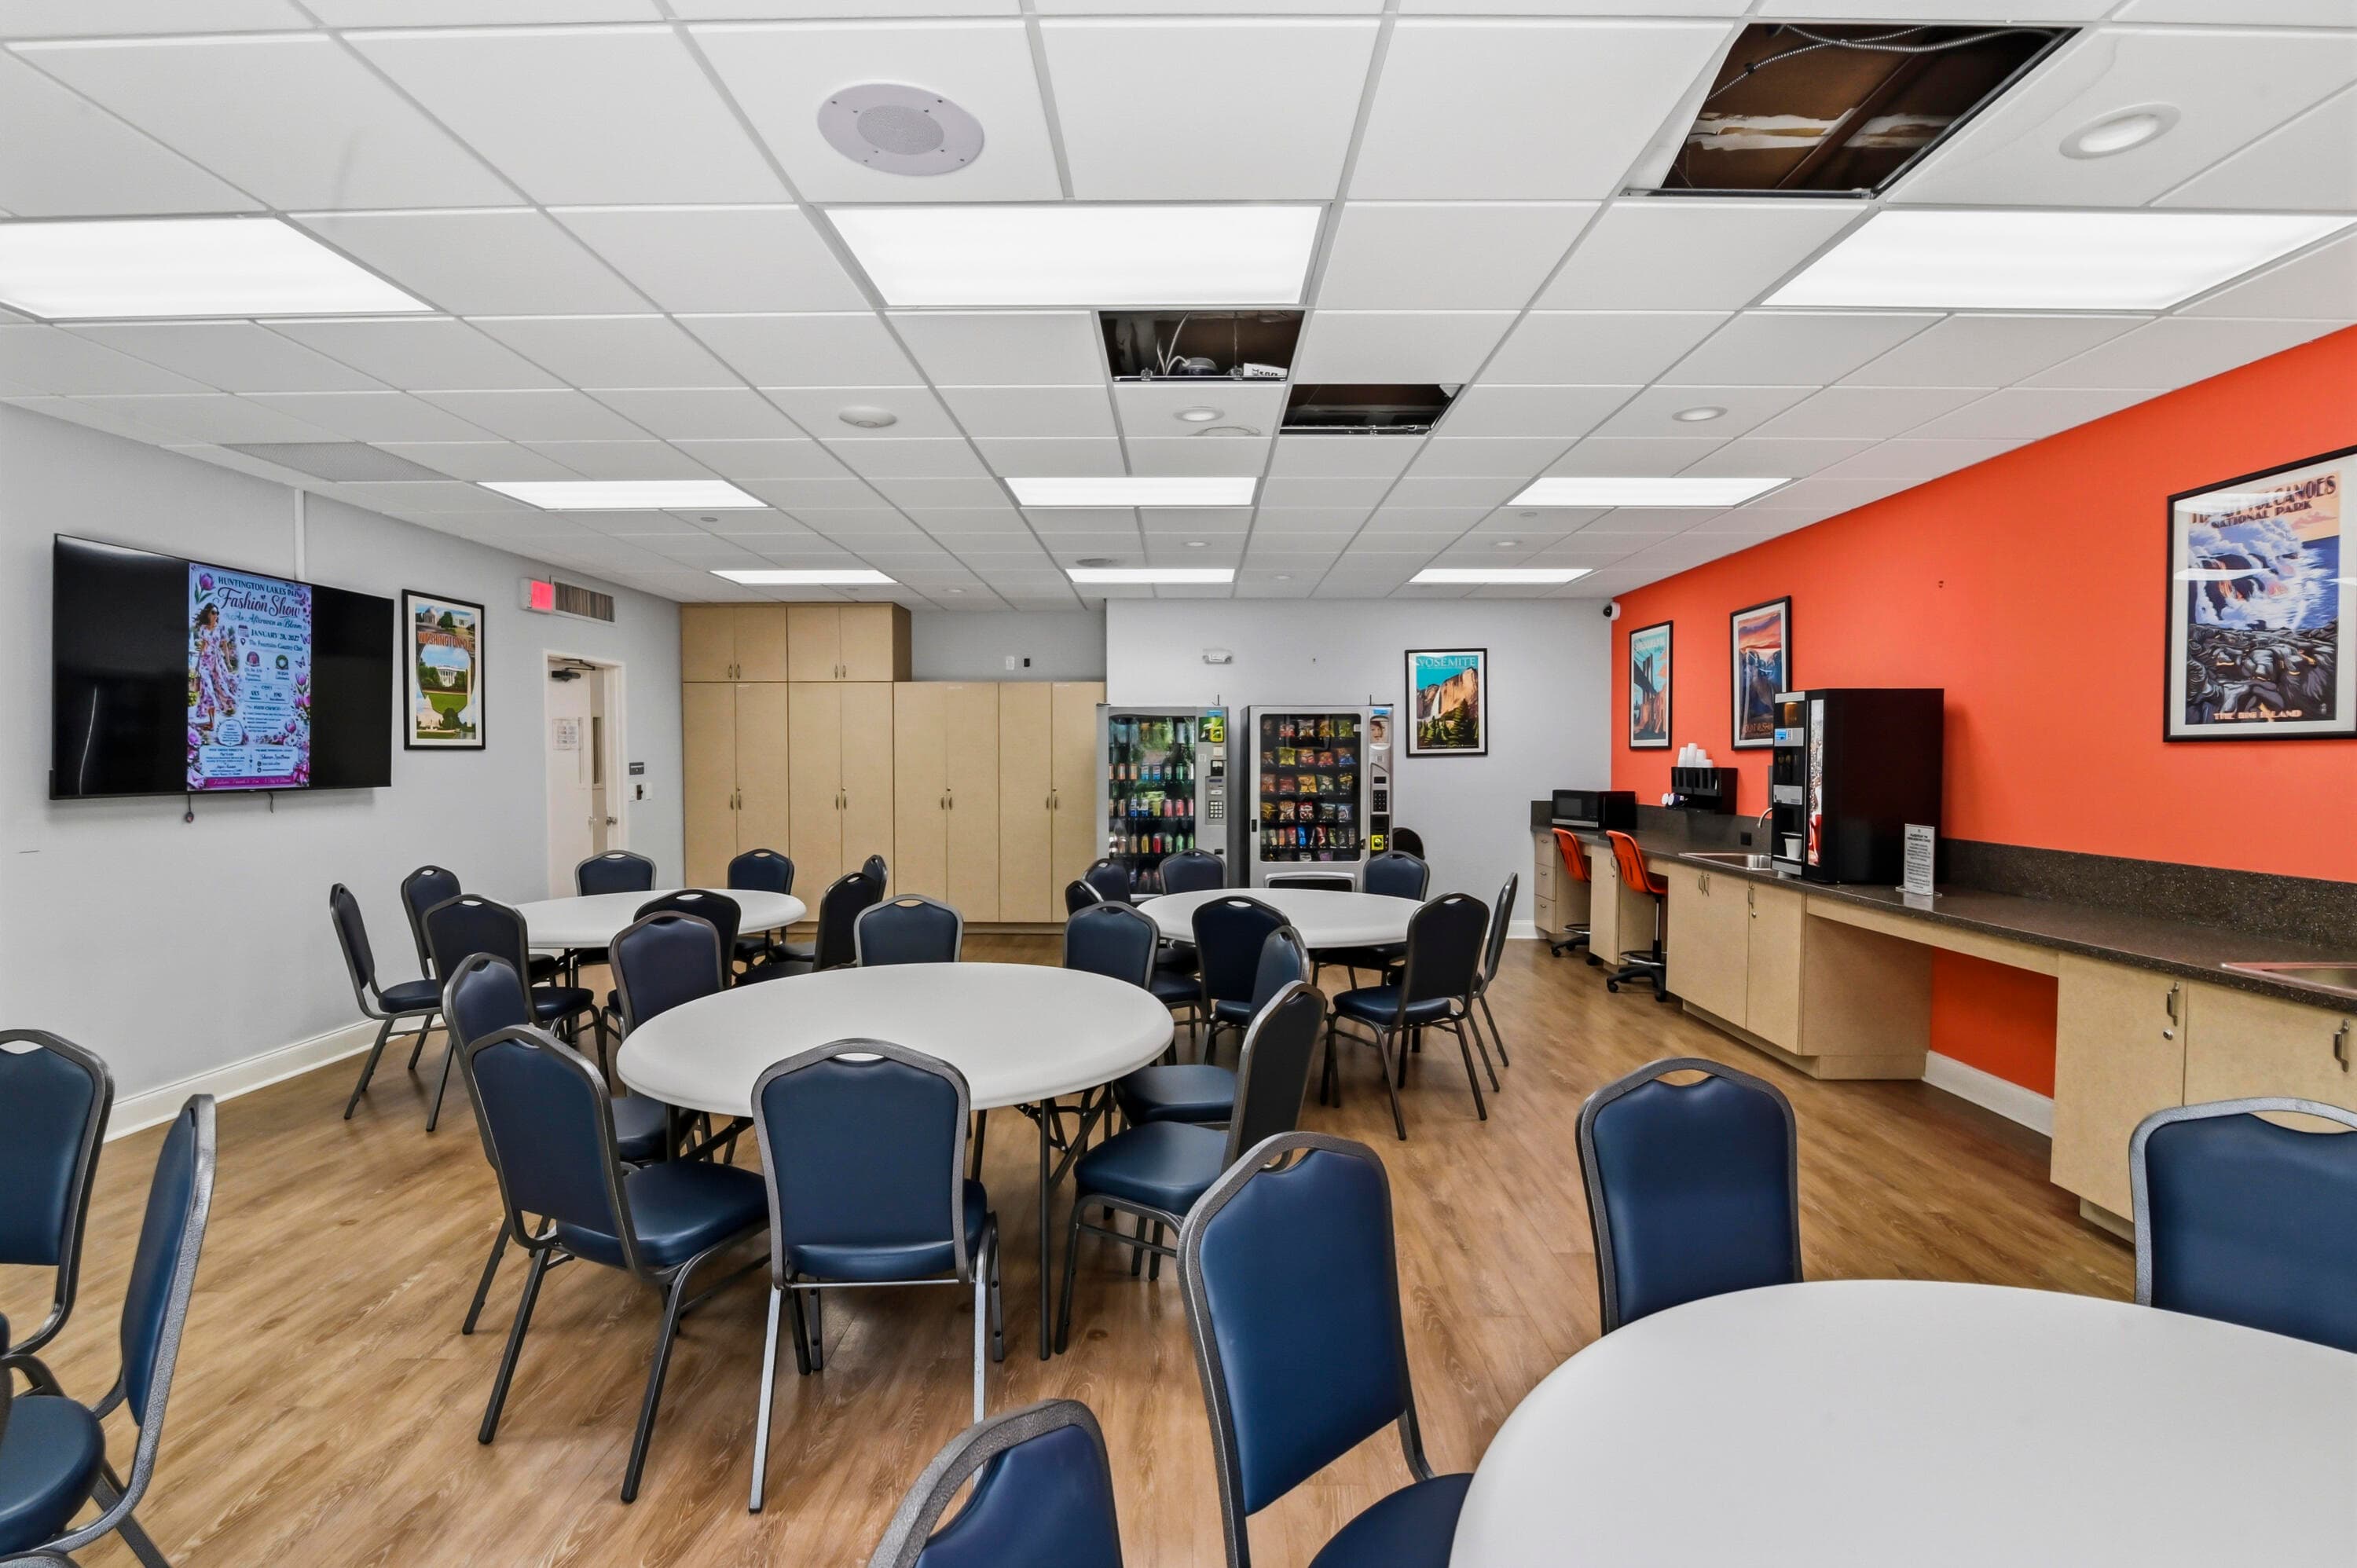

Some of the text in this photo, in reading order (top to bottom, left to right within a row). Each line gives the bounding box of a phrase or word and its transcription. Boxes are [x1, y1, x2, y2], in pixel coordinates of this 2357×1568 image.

[2275, 500, 2312, 516] PARK
[218, 576, 265, 592] HUNTINGTON
[266, 584, 286, 595] LAKES
[218, 587, 299, 617] Fashion Show
[251, 629, 277, 638] JANUARY
[418, 632, 462, 648] WASHINGTON
[1418, 657, 1476, 667] YOSEMITE
